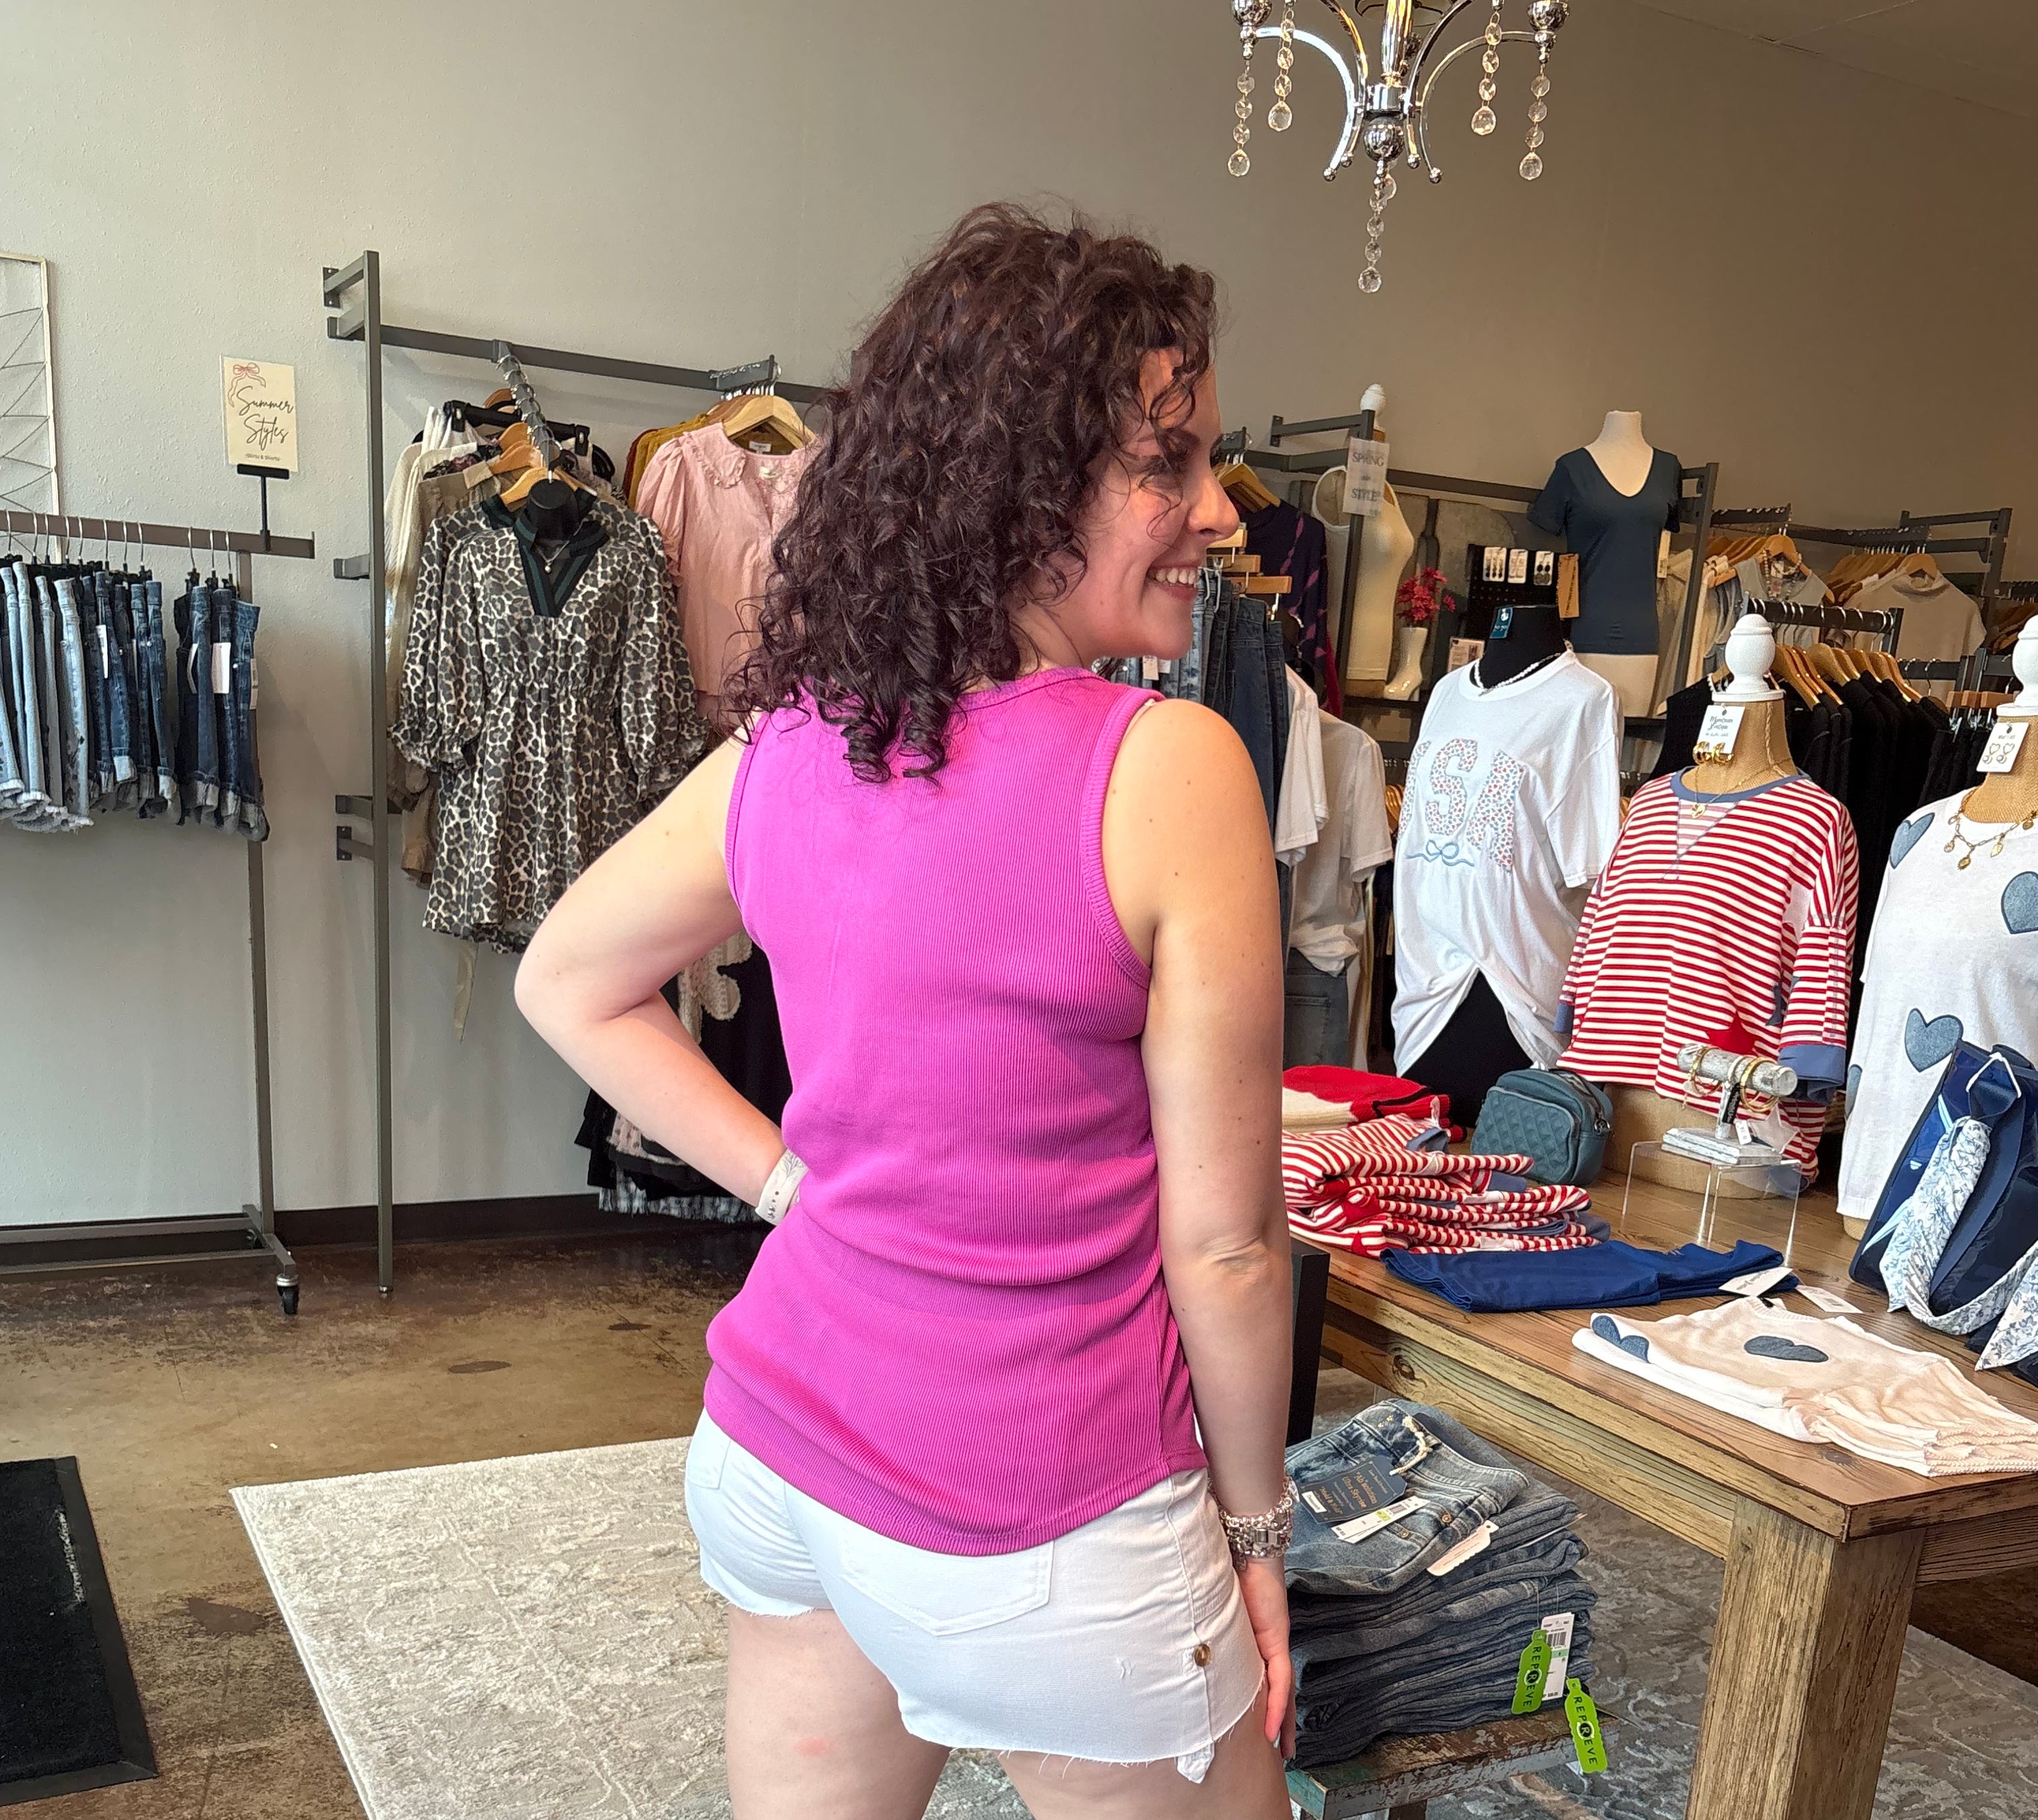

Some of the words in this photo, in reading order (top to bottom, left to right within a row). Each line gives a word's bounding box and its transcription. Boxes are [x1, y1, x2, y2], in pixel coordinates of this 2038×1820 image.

[236, 385, 294, 416] Summer
[243, 413, 289, 451] Styles
[1352, 452, 1385, 467] SPRING
[1342, 1476, 1353, 1490] Ultra
[1351, 1488, 1367, 1509] Skyrise
[1522, 1645, 1542, 1707] REPREVE
[1574, 1696, 1598, 1765] REPREVE
